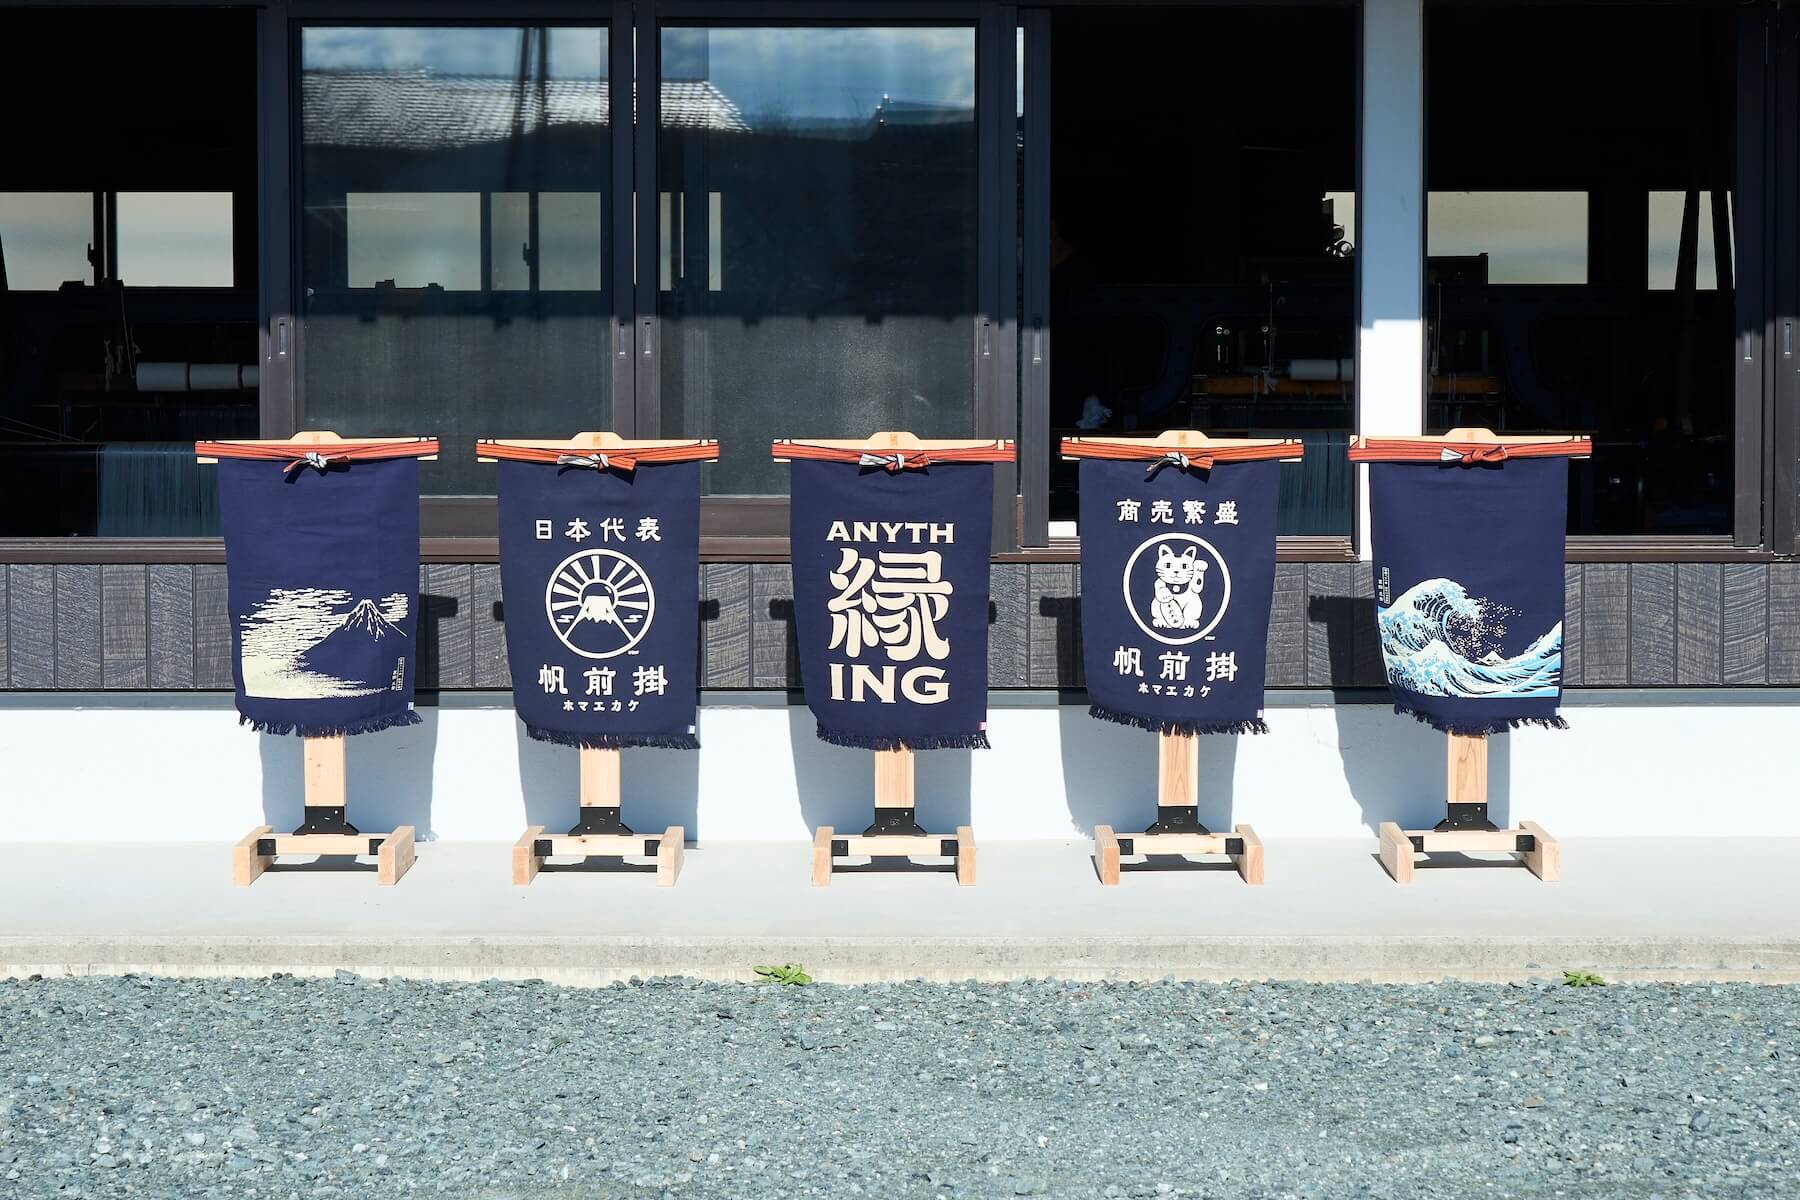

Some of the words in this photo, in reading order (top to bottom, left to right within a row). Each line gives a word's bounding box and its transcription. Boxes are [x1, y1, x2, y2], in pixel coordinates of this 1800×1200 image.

[1117, 498, 1239, 526] 商売繁盛
[535, 517, 662, 542] 日本代表
[826, 521, 955, 544] ANYTH
[827, 547, 954, 662] 縁
[1112, 645, 1239, 682] 帆前掛
[538, 664, 669, 696] 帆前掛
[829, 663, 950, 705] ING
[1137, 682, 1212, 698] ホマエカケ
[562, 699, 640, 712] ホマエカケ
